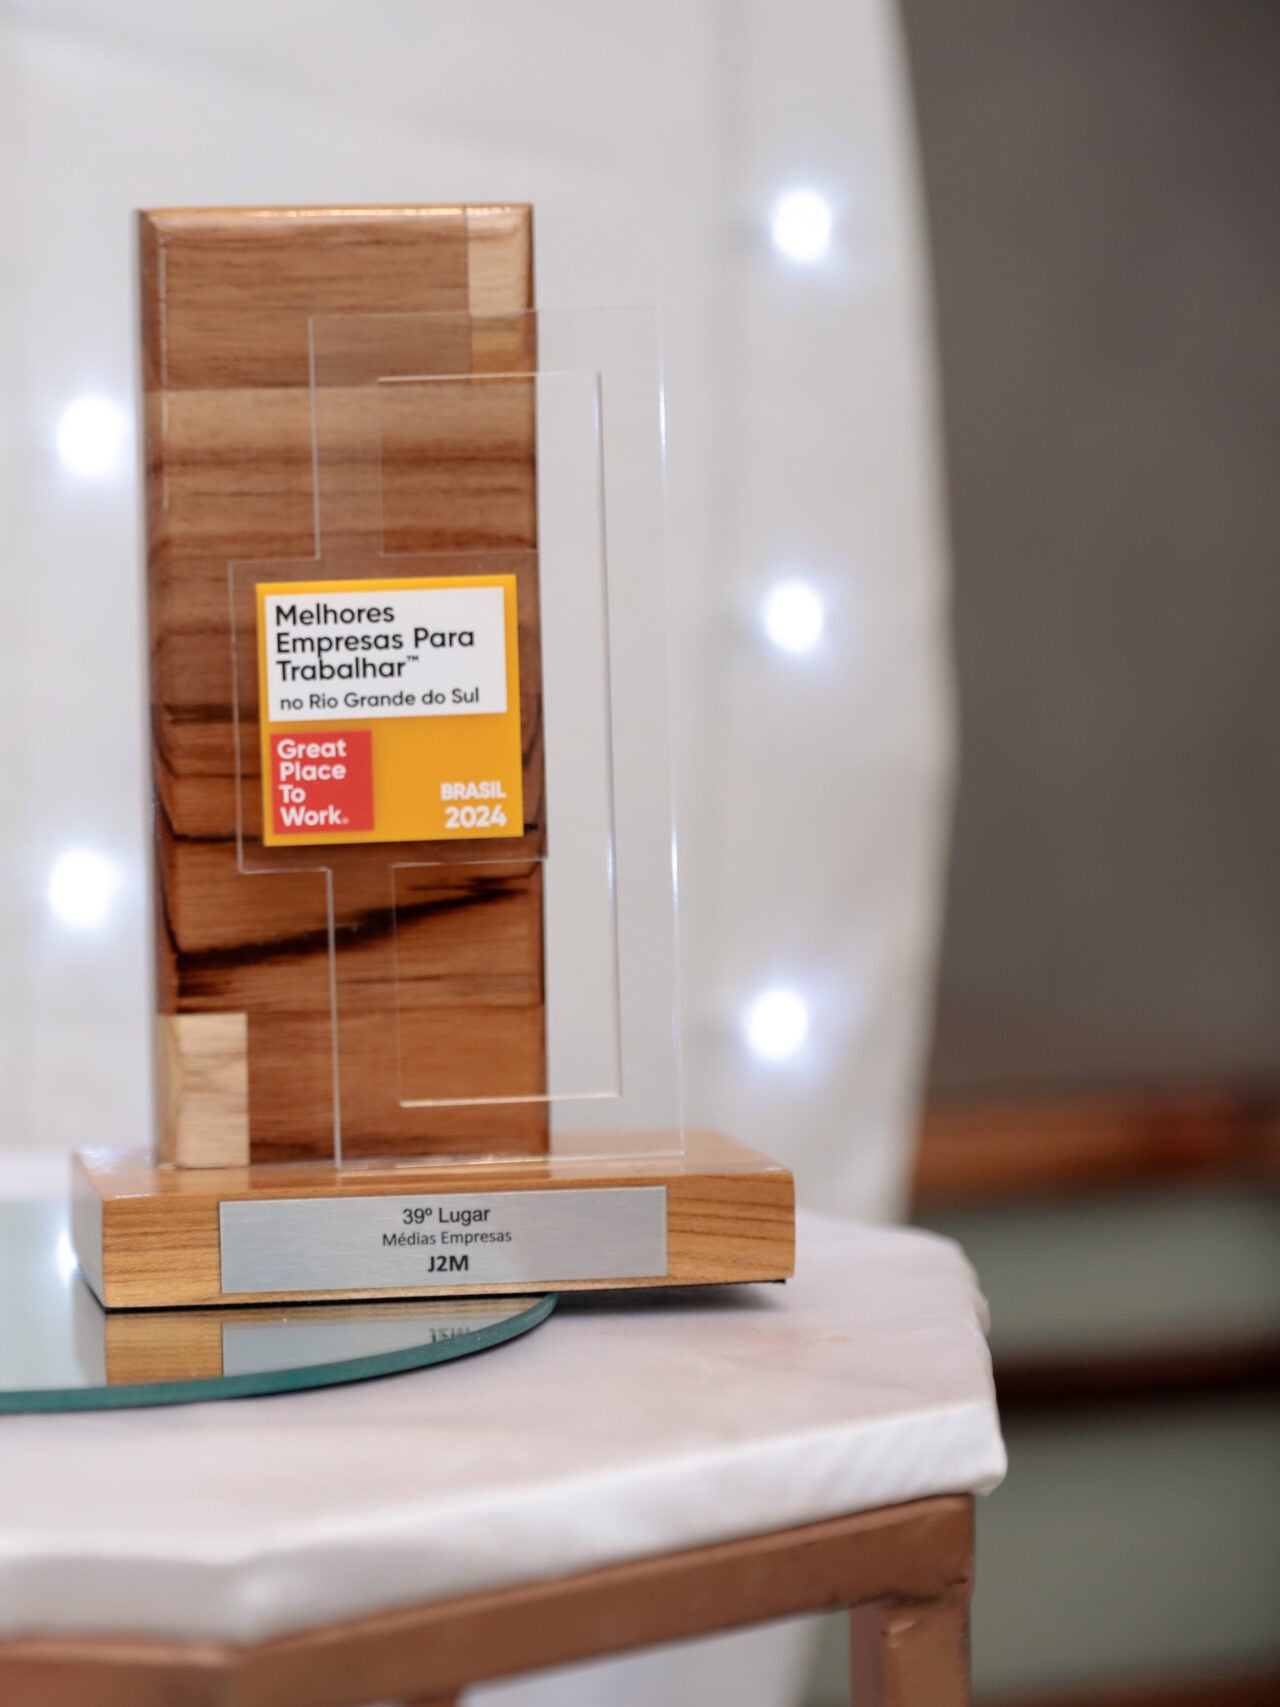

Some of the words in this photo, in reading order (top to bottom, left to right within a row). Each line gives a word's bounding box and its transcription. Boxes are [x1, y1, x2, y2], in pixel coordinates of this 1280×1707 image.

[275, 603, 395, 627] Melhores
[276, 632, 404, 657] Empresas
[413, 627, 475, 649] Para
[280, 696, 304, 710] no
[309, 693, 338, 709] Rio
[344, 690, 416, 708] Grande
[421, 689, 446, 705] do
[451, 687, 480, 703] Sul
[276, 739, 348, 760] Great
[279, 762, 347, 782] Place
[278, 785, 307, 804] To
[440, 781, 507, 801] BRASIL
[444, 804, 508, 829] 2024
[438, 1207, 490, 1226] Lugar
[382, 1232, 437, 1247] Médias
[441, 1230, 512, 1246] Empresas
[427, 1255, 469, 1273] J2M
